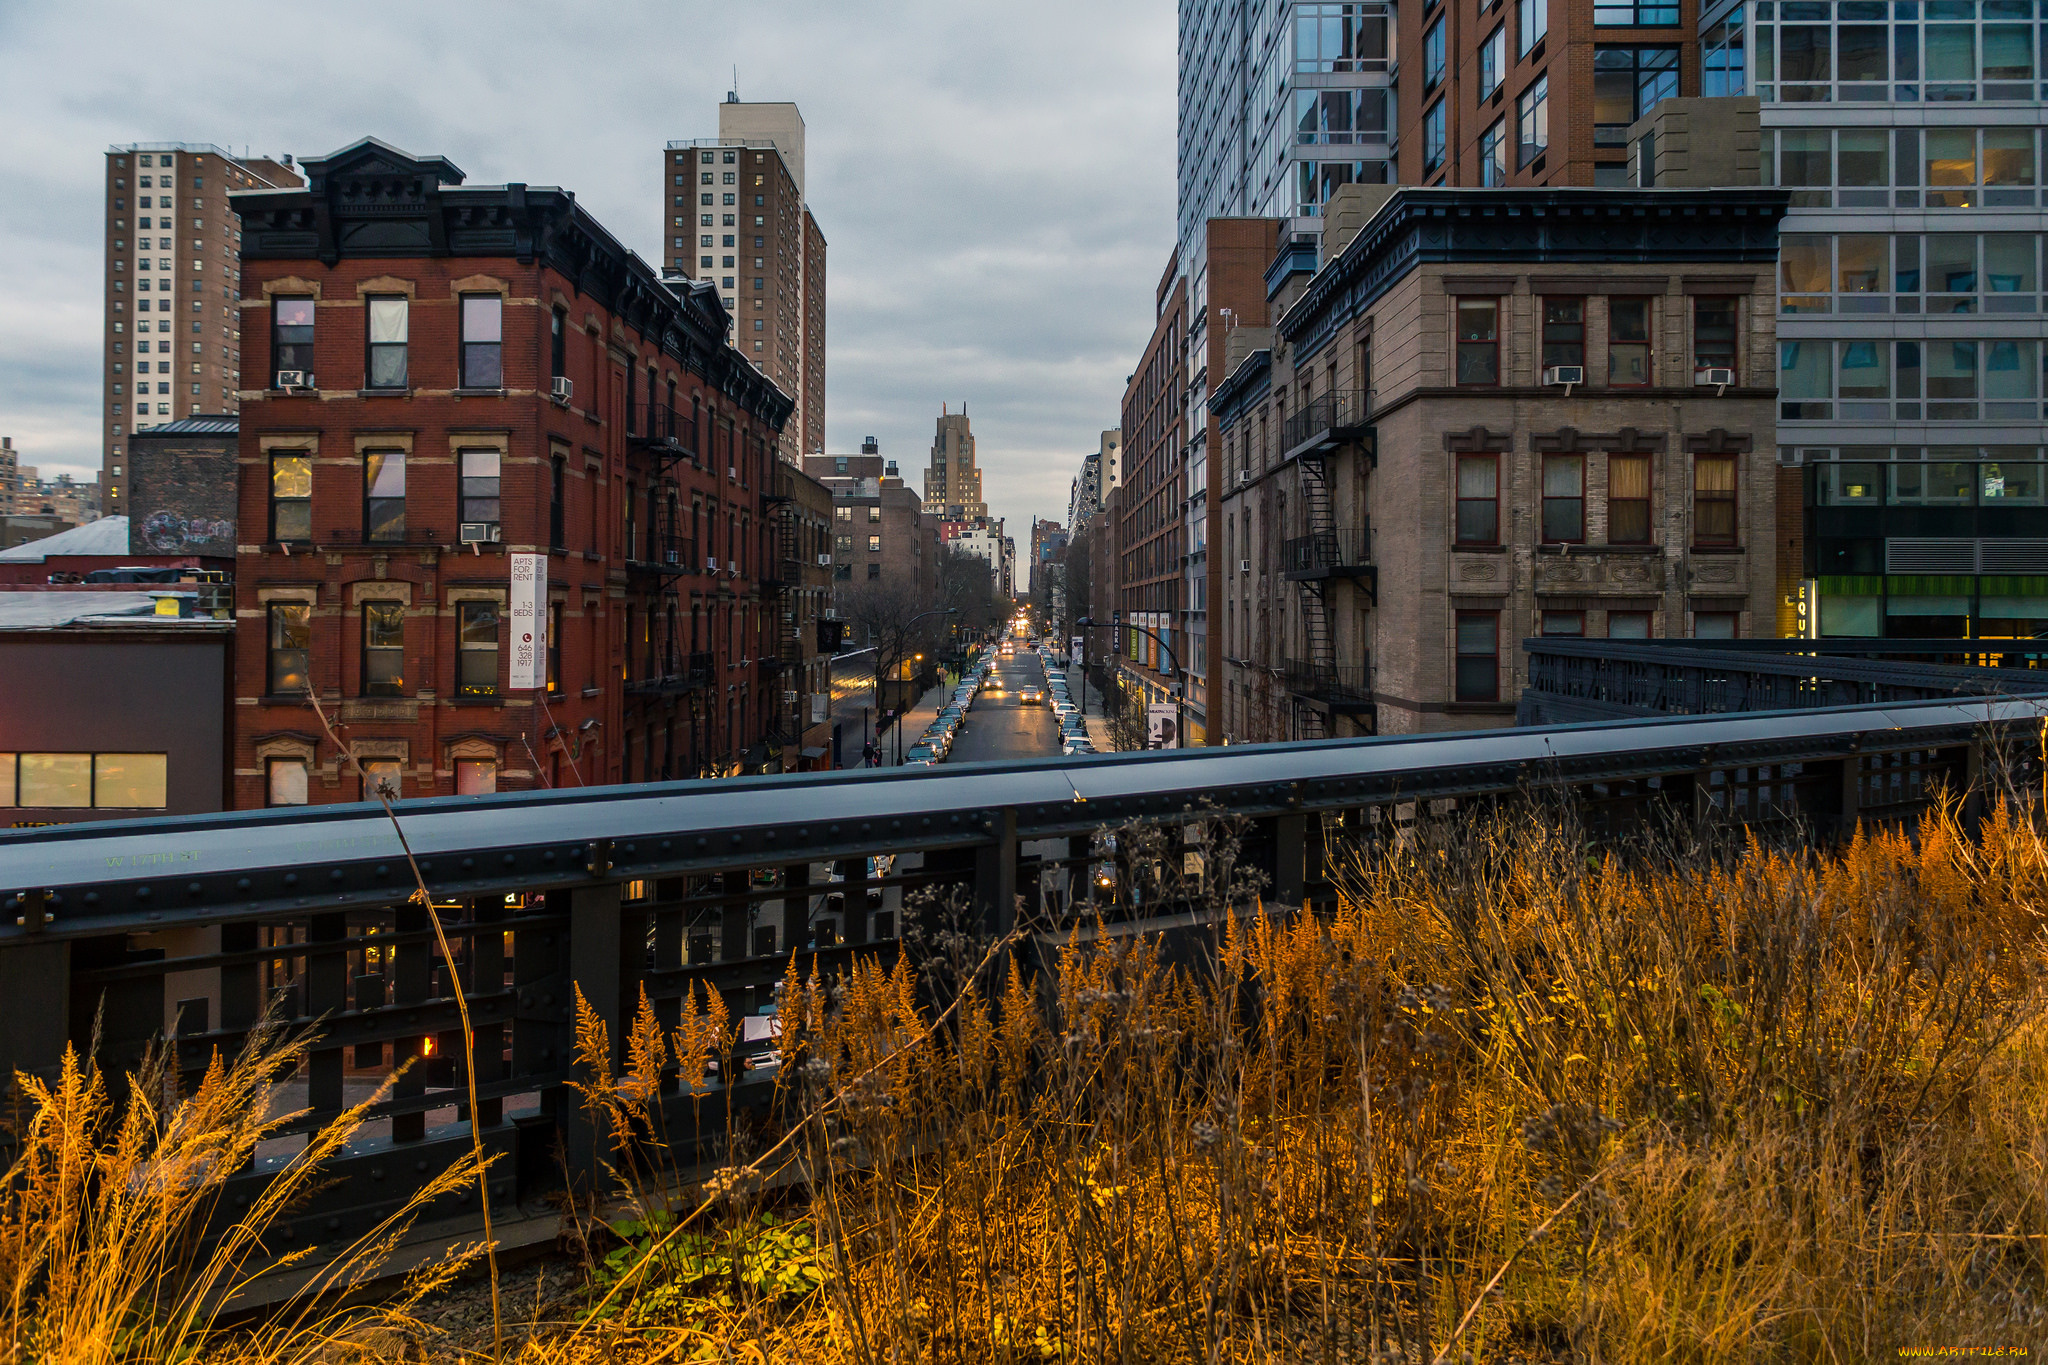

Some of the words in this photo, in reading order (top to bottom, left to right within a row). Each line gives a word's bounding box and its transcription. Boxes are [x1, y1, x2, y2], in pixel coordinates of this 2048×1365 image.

[513, 609, 533, 617] BEDS
[105, 856, 125, 867] W
[131, 851, 175, 866] 17TH
[180, 849, 201, 862] ST
